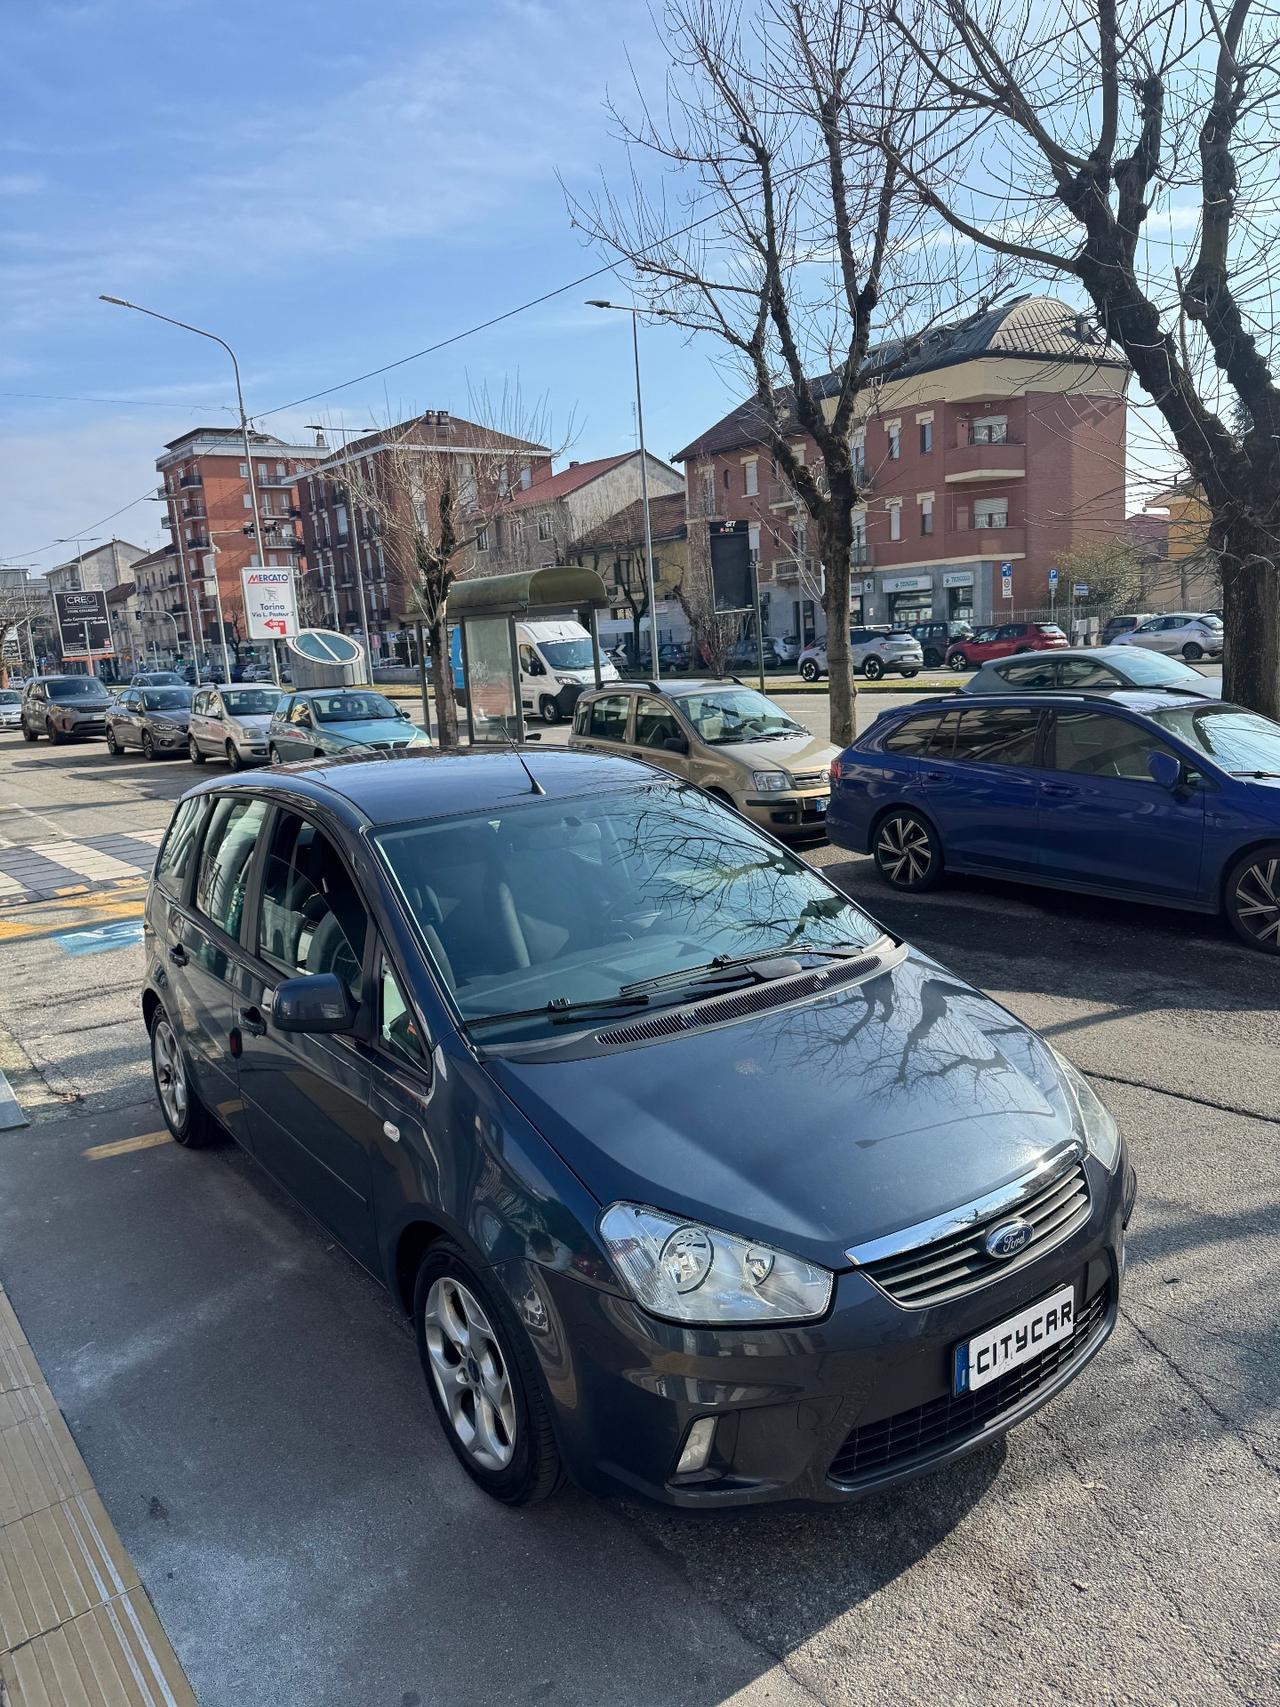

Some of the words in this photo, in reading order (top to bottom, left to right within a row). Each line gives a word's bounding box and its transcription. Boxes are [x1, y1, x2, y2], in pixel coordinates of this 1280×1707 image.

[260, 602, 285, 610] Torino
[1003, 1229, 1026, 1253] Ford
[976, 1300, 1072, 1375] CITYCAR
